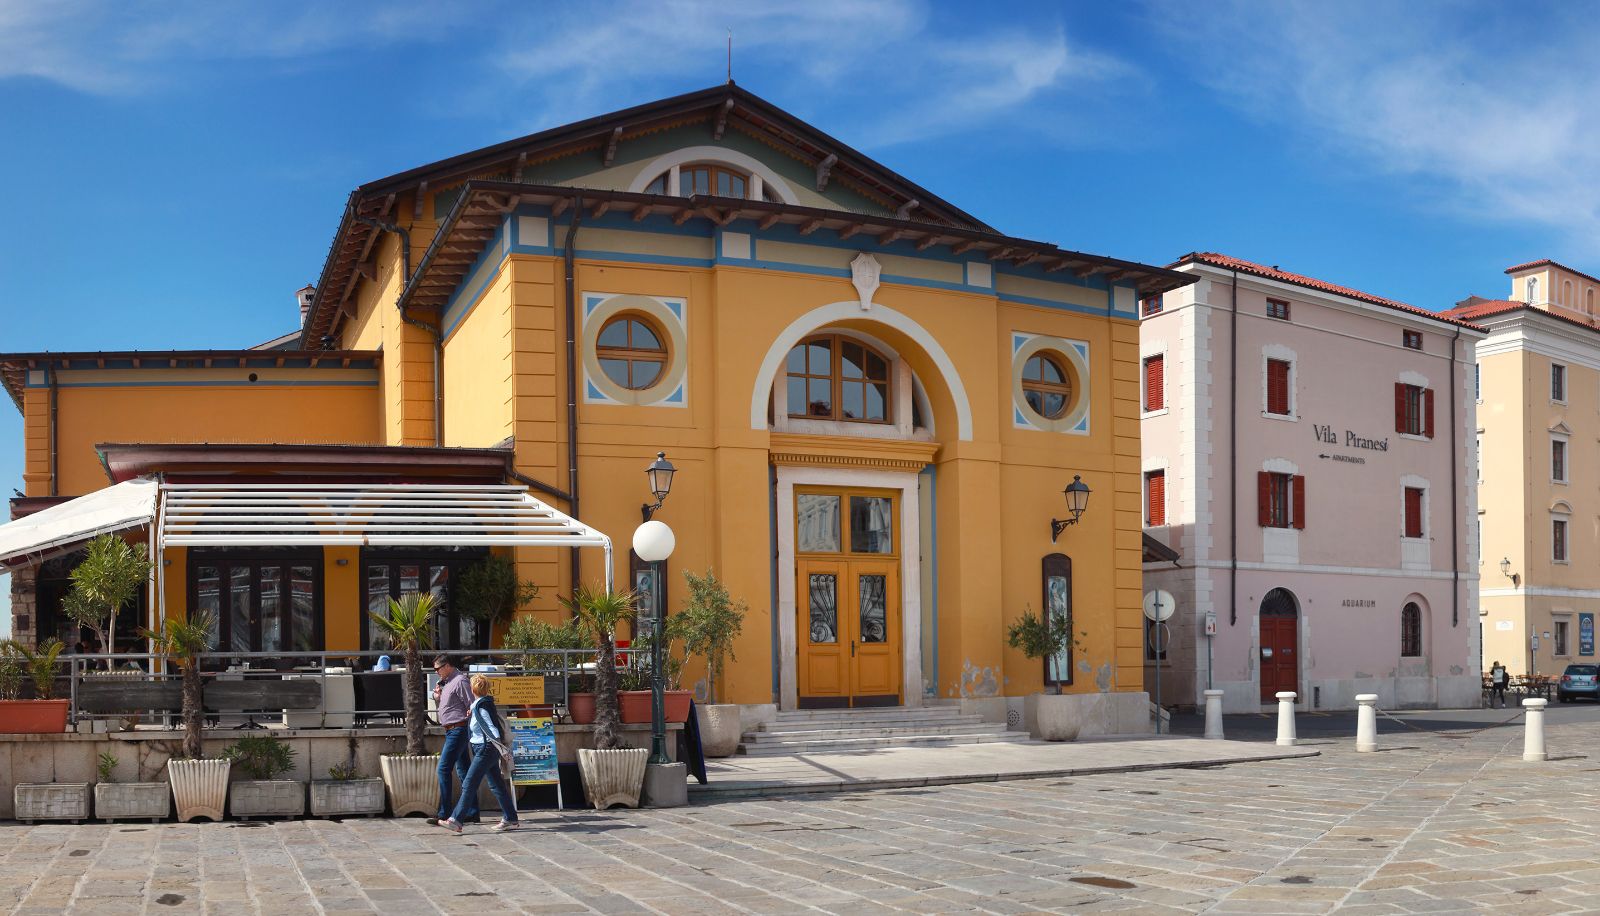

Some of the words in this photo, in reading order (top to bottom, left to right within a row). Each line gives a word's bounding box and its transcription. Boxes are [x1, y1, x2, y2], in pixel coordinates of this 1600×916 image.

[1313, 424, 1338, 444] Vila
[1346, 430, 1388, 452] Piranesi
[1342, 599, 1376, 608] AQUARIUM
